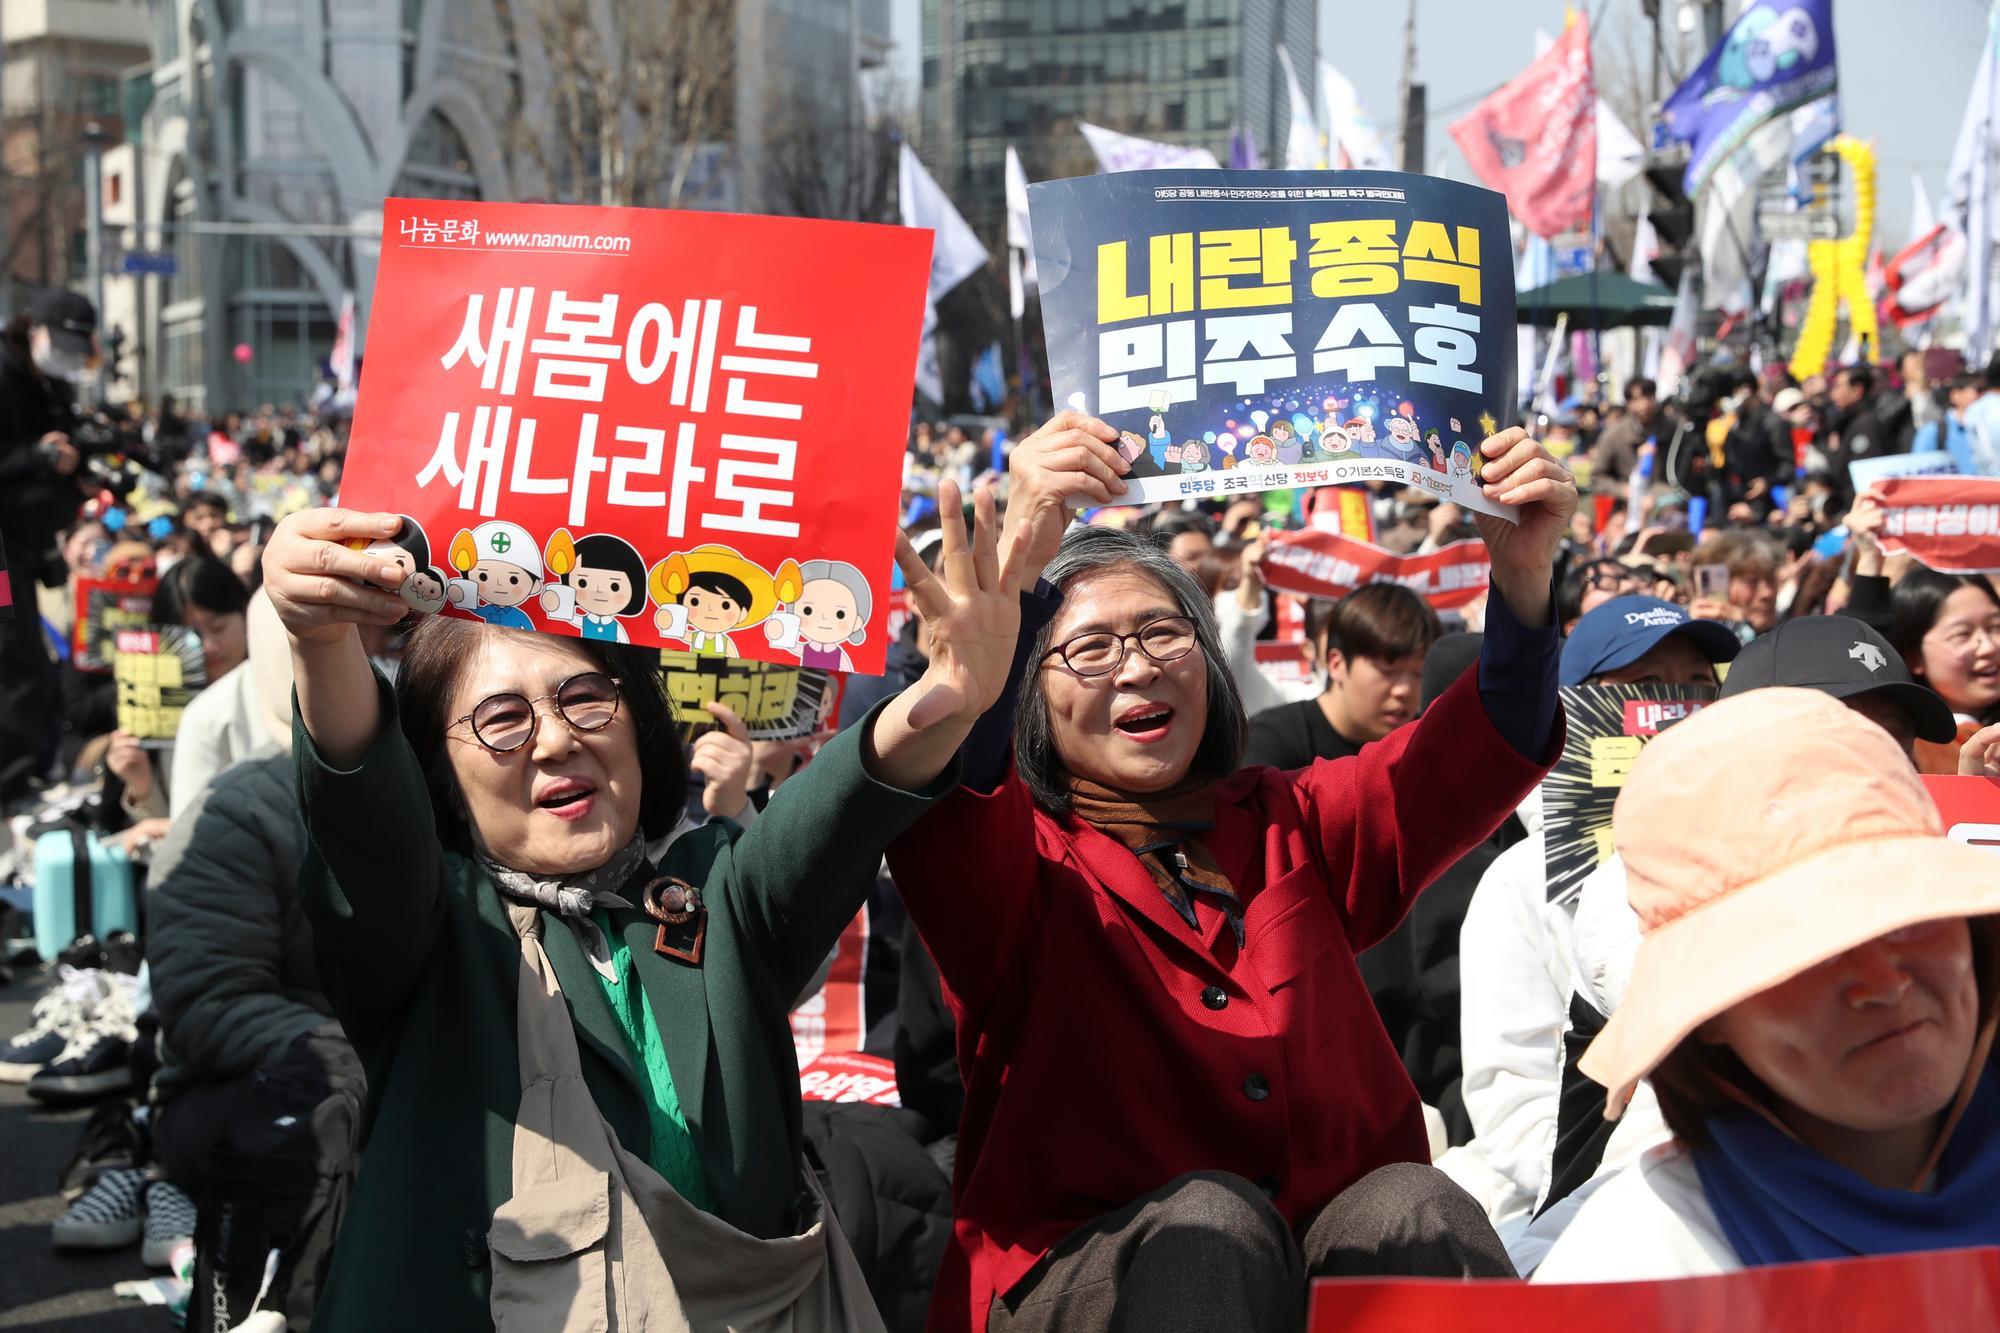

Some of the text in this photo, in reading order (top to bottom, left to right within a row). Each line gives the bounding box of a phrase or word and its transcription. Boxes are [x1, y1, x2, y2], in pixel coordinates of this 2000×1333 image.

[1287, 189, 1304, 198] 위한
[399, 217, 632, 252] 나눔문화 www.nanum.com
[1097, 219, 1482, 325] 내란 종식
[440, 286, 819, 420] 새봄에는
[1098, 302, 1483, 414] 민주 수호
[415, 405, 801, 539] 새나라로
[1179, 478, 1216, 494] 민주당
[1223, 473, 1288, 490] 조국혁신당
[1294, 469, 1329, 483] 진보당
[1348, 466, 1405, 482] 기본소득당
[1624, 606, 1683, 625] Deadline
